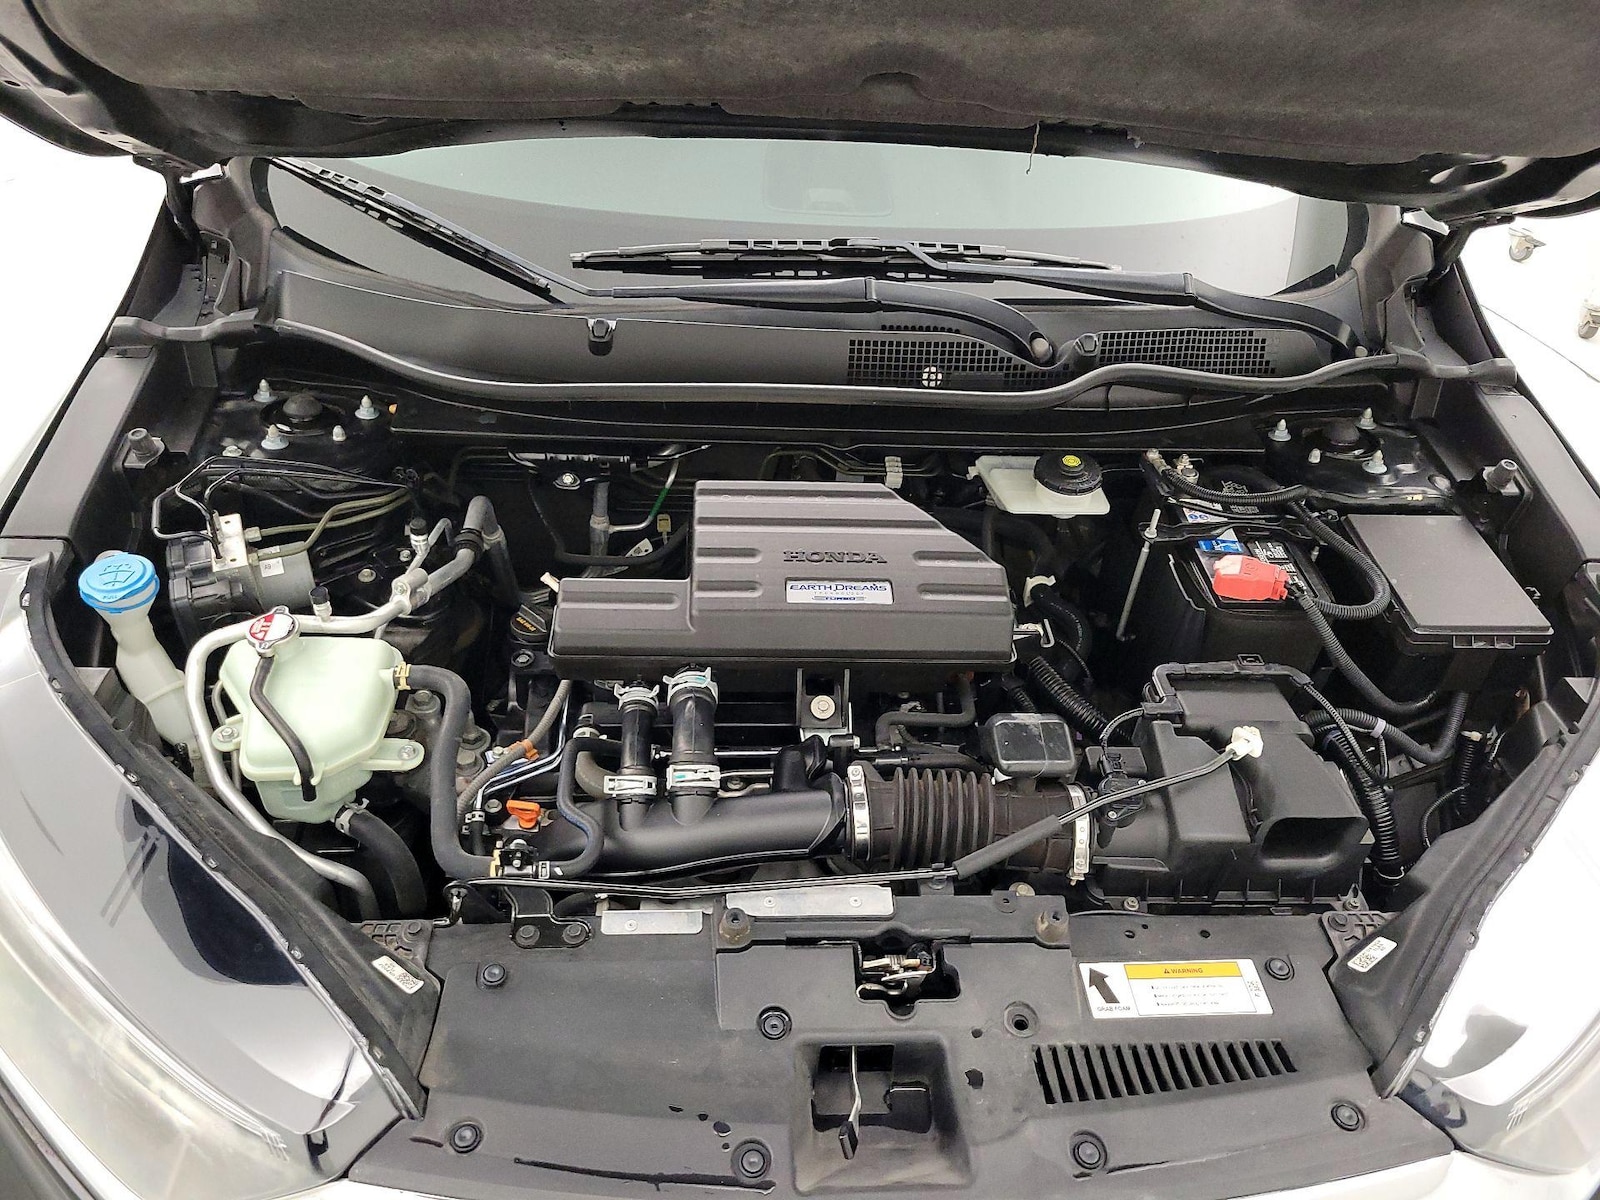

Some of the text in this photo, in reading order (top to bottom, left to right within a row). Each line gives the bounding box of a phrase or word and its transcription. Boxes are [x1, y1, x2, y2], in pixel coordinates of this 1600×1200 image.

[783, 551, 888, 564] HONDA
[789, 584, 832, 592] EARTH
[1170, 967, 1204, 975] WARNING
